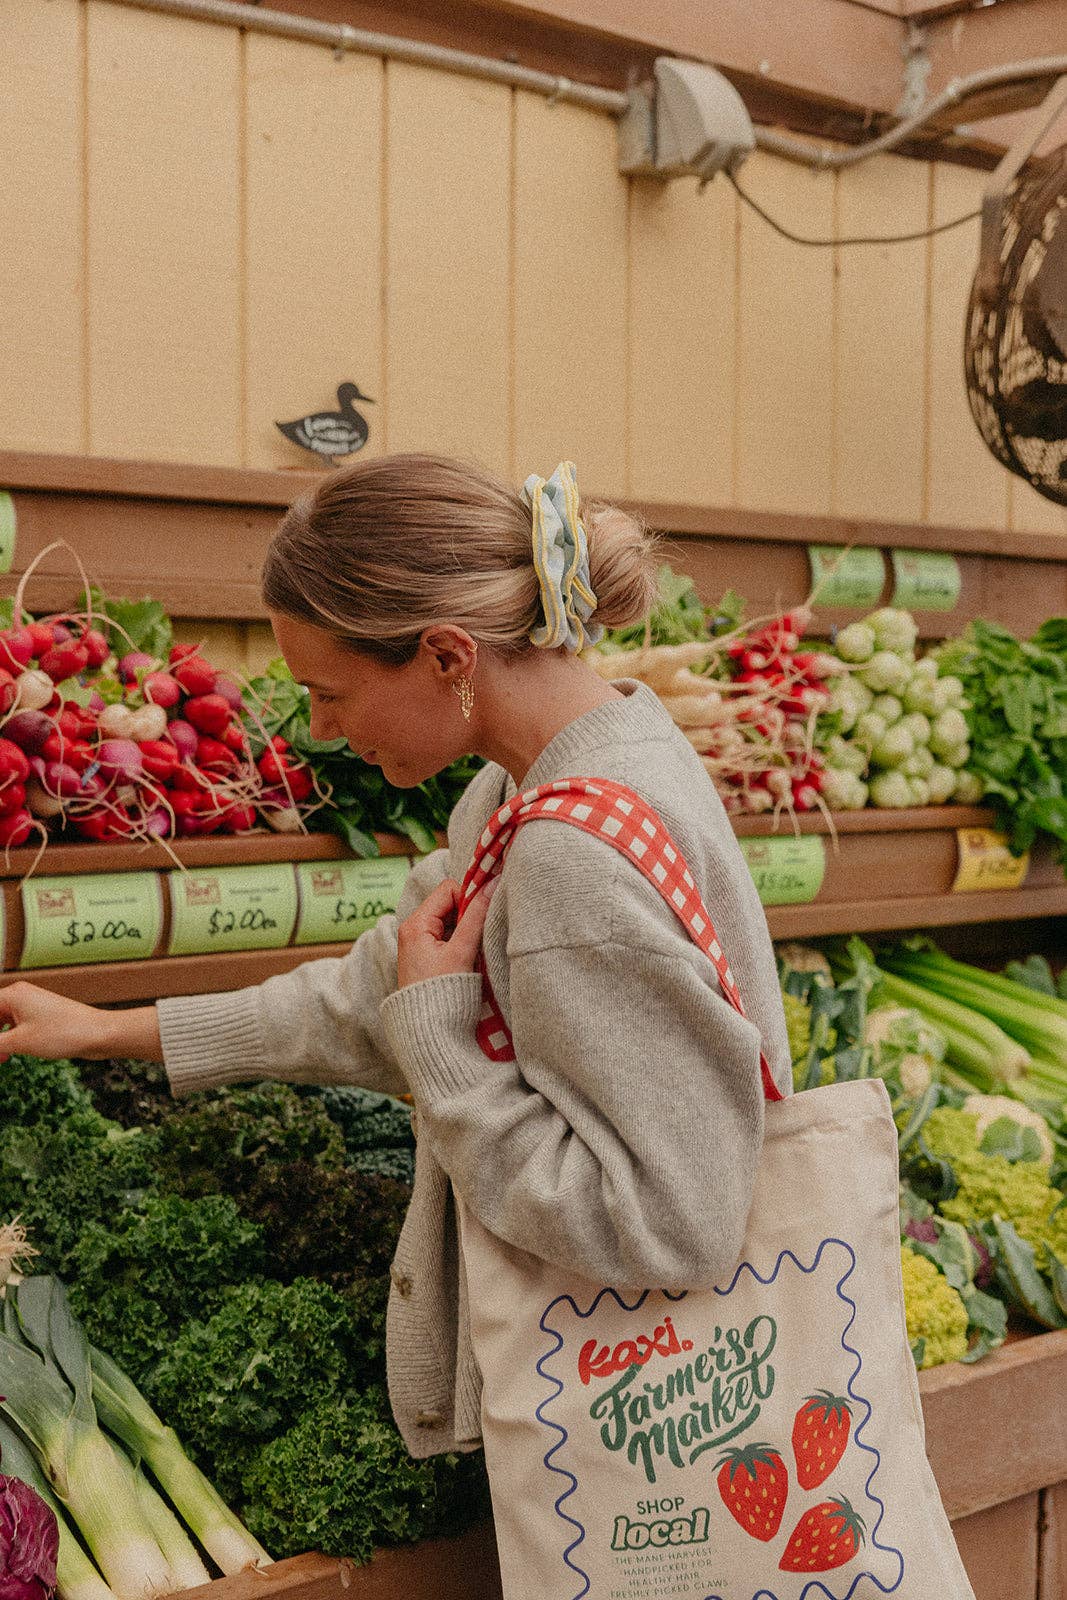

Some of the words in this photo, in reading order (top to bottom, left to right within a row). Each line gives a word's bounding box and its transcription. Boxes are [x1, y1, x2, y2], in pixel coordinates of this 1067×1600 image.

[636, 1496, 685, 1514] SHOP
[610, 1507, 710, 1551] local
[615, 1556, 632, 1565] THE
[636, 1554, 664, 1563] MANE
[668, 1547, 713, 1560] HARVEST
[623, 1562, 688, 1576] HANDPICKED
[692, 1558, 713, 1567] FOR
[629, 1576, 672, 1587] HEALTHY
[676, 1572, 701, 1581] HAIR
[610, 1589, 650, 1600] FRESHLY
[654, 1583, 690, 1596] PICKED
[693, 1578, 729, 1591] CLAWS
